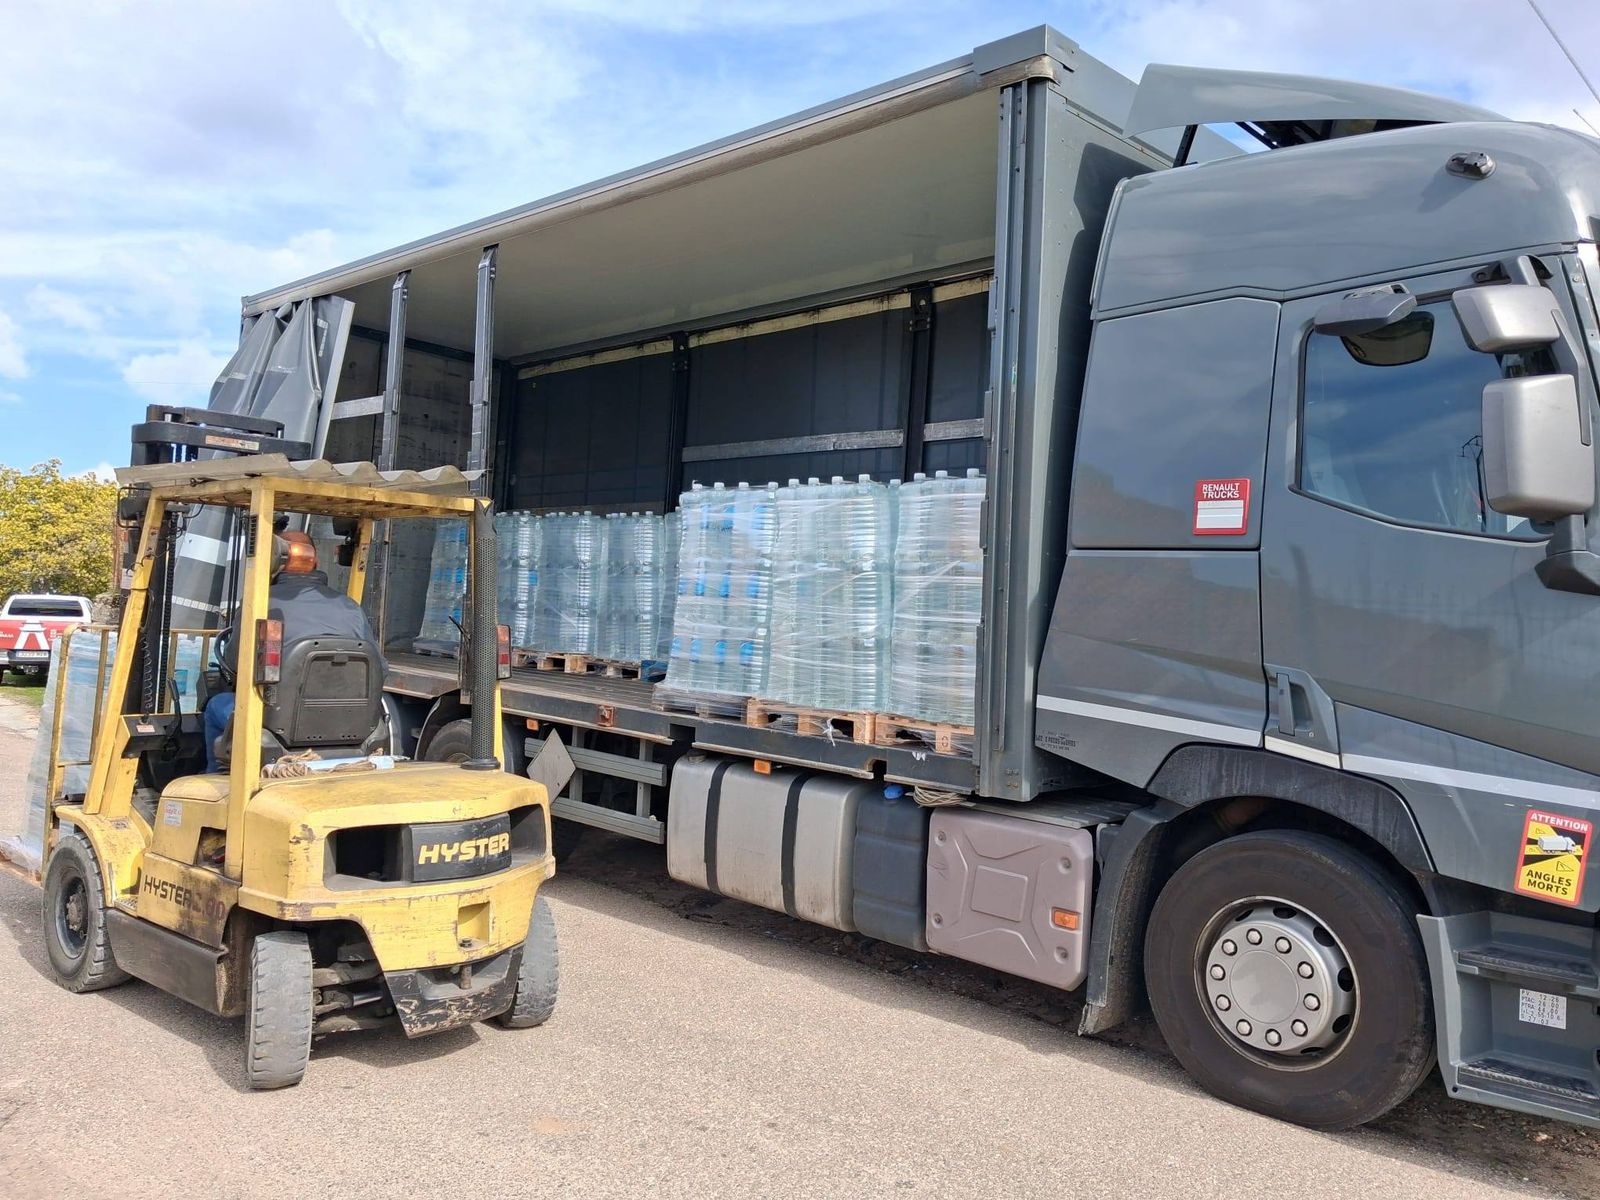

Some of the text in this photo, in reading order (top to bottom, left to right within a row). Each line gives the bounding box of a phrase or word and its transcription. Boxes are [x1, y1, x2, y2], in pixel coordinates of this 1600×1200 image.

[1202, 483, 1240, 492] RENAULT
[1202, 491, 1240, 499] TRUCKS
[1530, 812, 1588, 832] ATTENTION
[418, 832, 510, 865] HYSTER
[1526, 869, 1572, 887] ANGLES
[143, 874, 192, 907] HYSTER
[1527, 879, 1568, 896] MORTS
